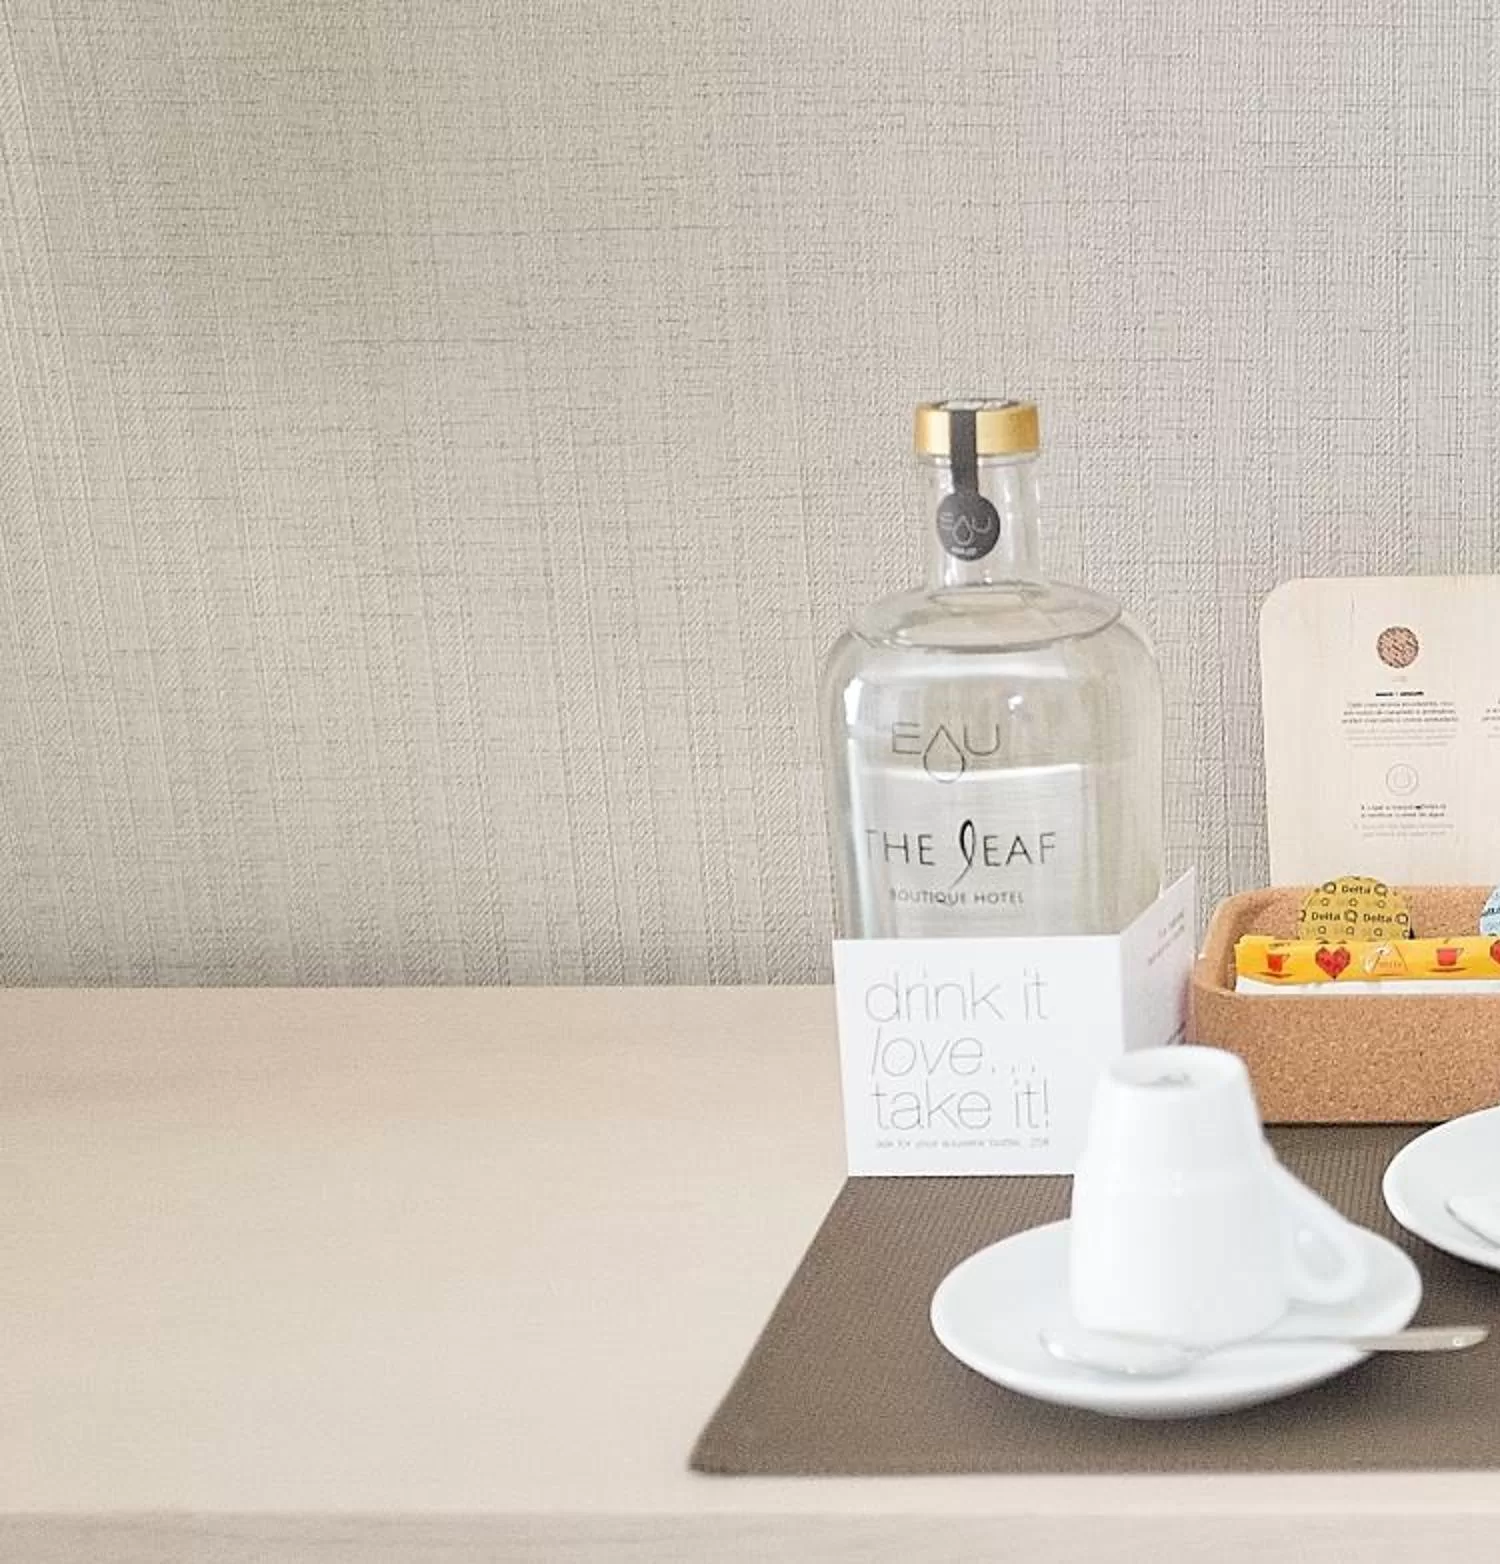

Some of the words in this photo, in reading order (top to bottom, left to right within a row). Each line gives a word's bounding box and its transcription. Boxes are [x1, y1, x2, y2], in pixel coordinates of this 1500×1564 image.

[865, 829, 936, 866] THE
[890, 888, 966, 906] BOUTIQUE
[973, 890, 1025, 905] HOTEL
[864, 967, 1006, 1023] drink
[1022, 967, 1049, 1021] it
[871, 1078, 993, 1131] take
[1012, 1076, 1052, 1130] it!
